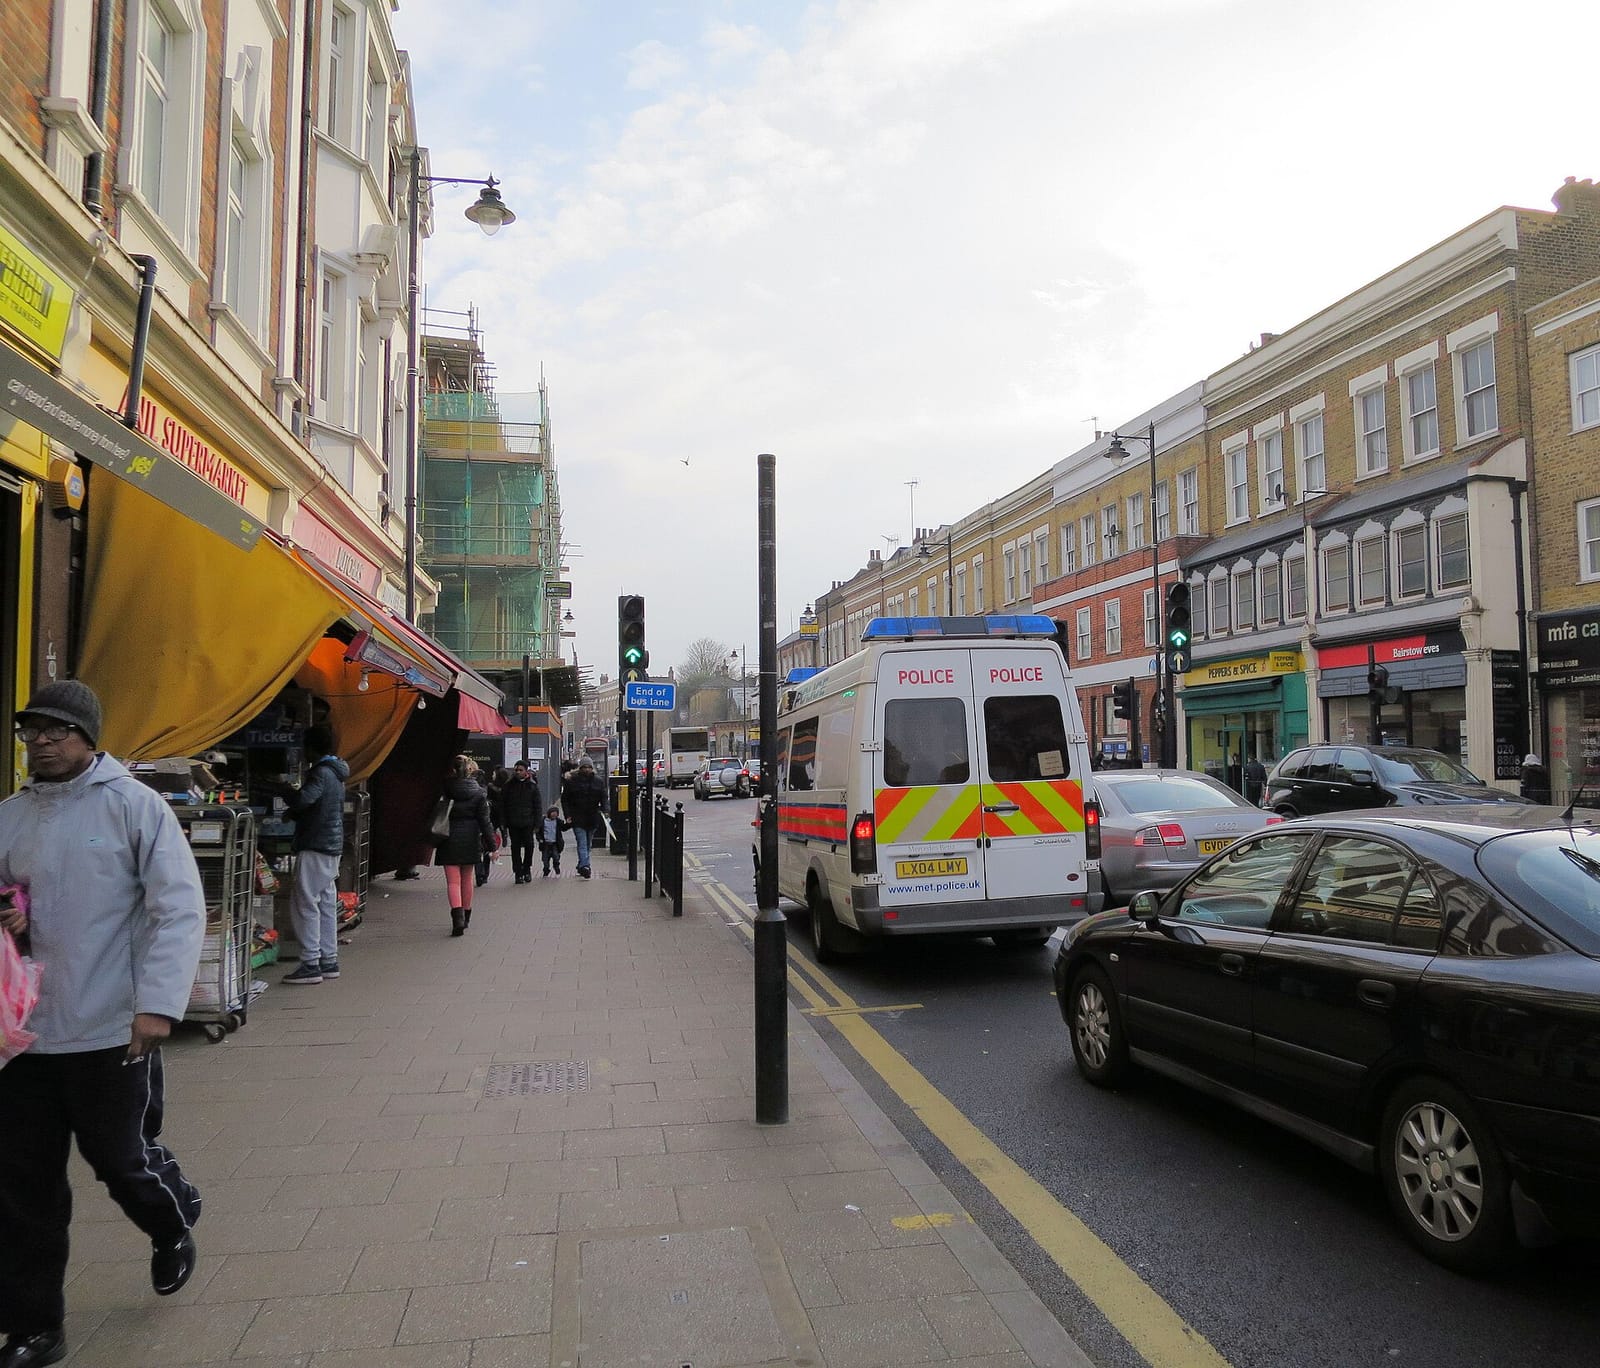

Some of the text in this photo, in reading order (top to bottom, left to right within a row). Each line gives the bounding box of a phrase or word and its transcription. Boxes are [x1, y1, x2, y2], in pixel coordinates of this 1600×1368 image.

[162, 416, 249, 506] SUPERMARKET
[1548, 621, 1577, 641] mfa
[1393, 644, 1440, 658] Bairstow eves
[898, 669, 954, 685] POLICE
[989, 667, 1043, 683] POLICE
[1208, 662, 1258, 679] PEPPERS & SPICE
[636, 686, 667, 697] End of
[631, 697, 670, 707] bus lane
[248, 730, 296, 743] Ticket
[1497, 744, 1514, 754] 020
[902, 860, 962, 876] LX04 LMY
[888, 879, 981, 894] www.met.police.uk
